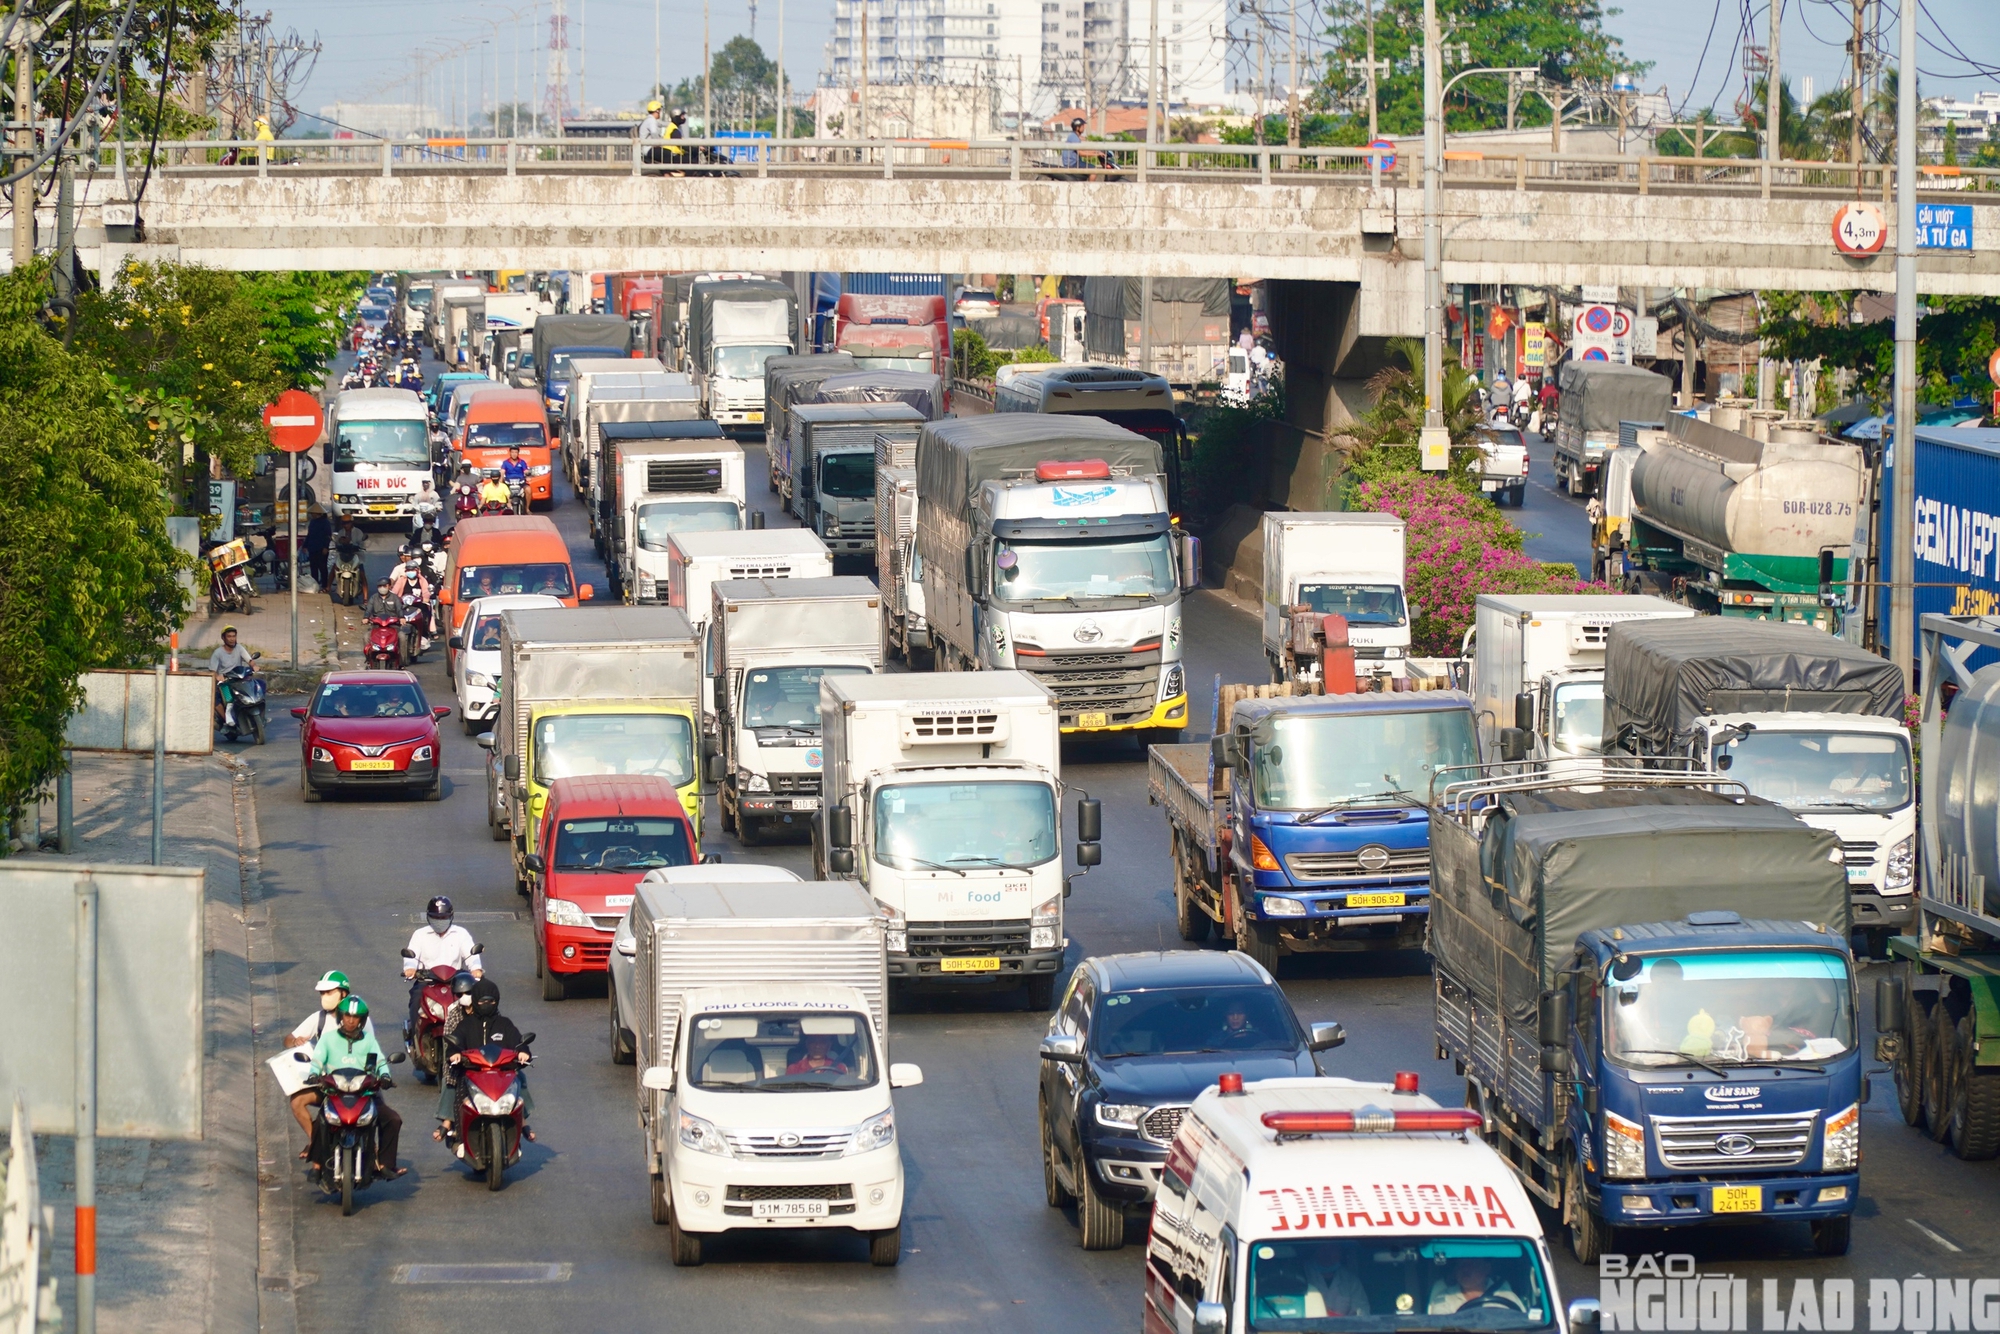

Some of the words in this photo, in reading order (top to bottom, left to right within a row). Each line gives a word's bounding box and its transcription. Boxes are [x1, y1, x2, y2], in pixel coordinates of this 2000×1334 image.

[1951, 228, 1967, 247] GA
[938, 892, 954, 902] Mi
[967, 891, 1001, 902] food
[704, 1003, 737, 1011] PHU
[803, 1001, 849, 1010] AUTO
[1733, 1086, 1760, 1096] SANG
[1726, 1189, 1748, 1199] 50H
[1718, 1199, 1757, 1211] 241.55
